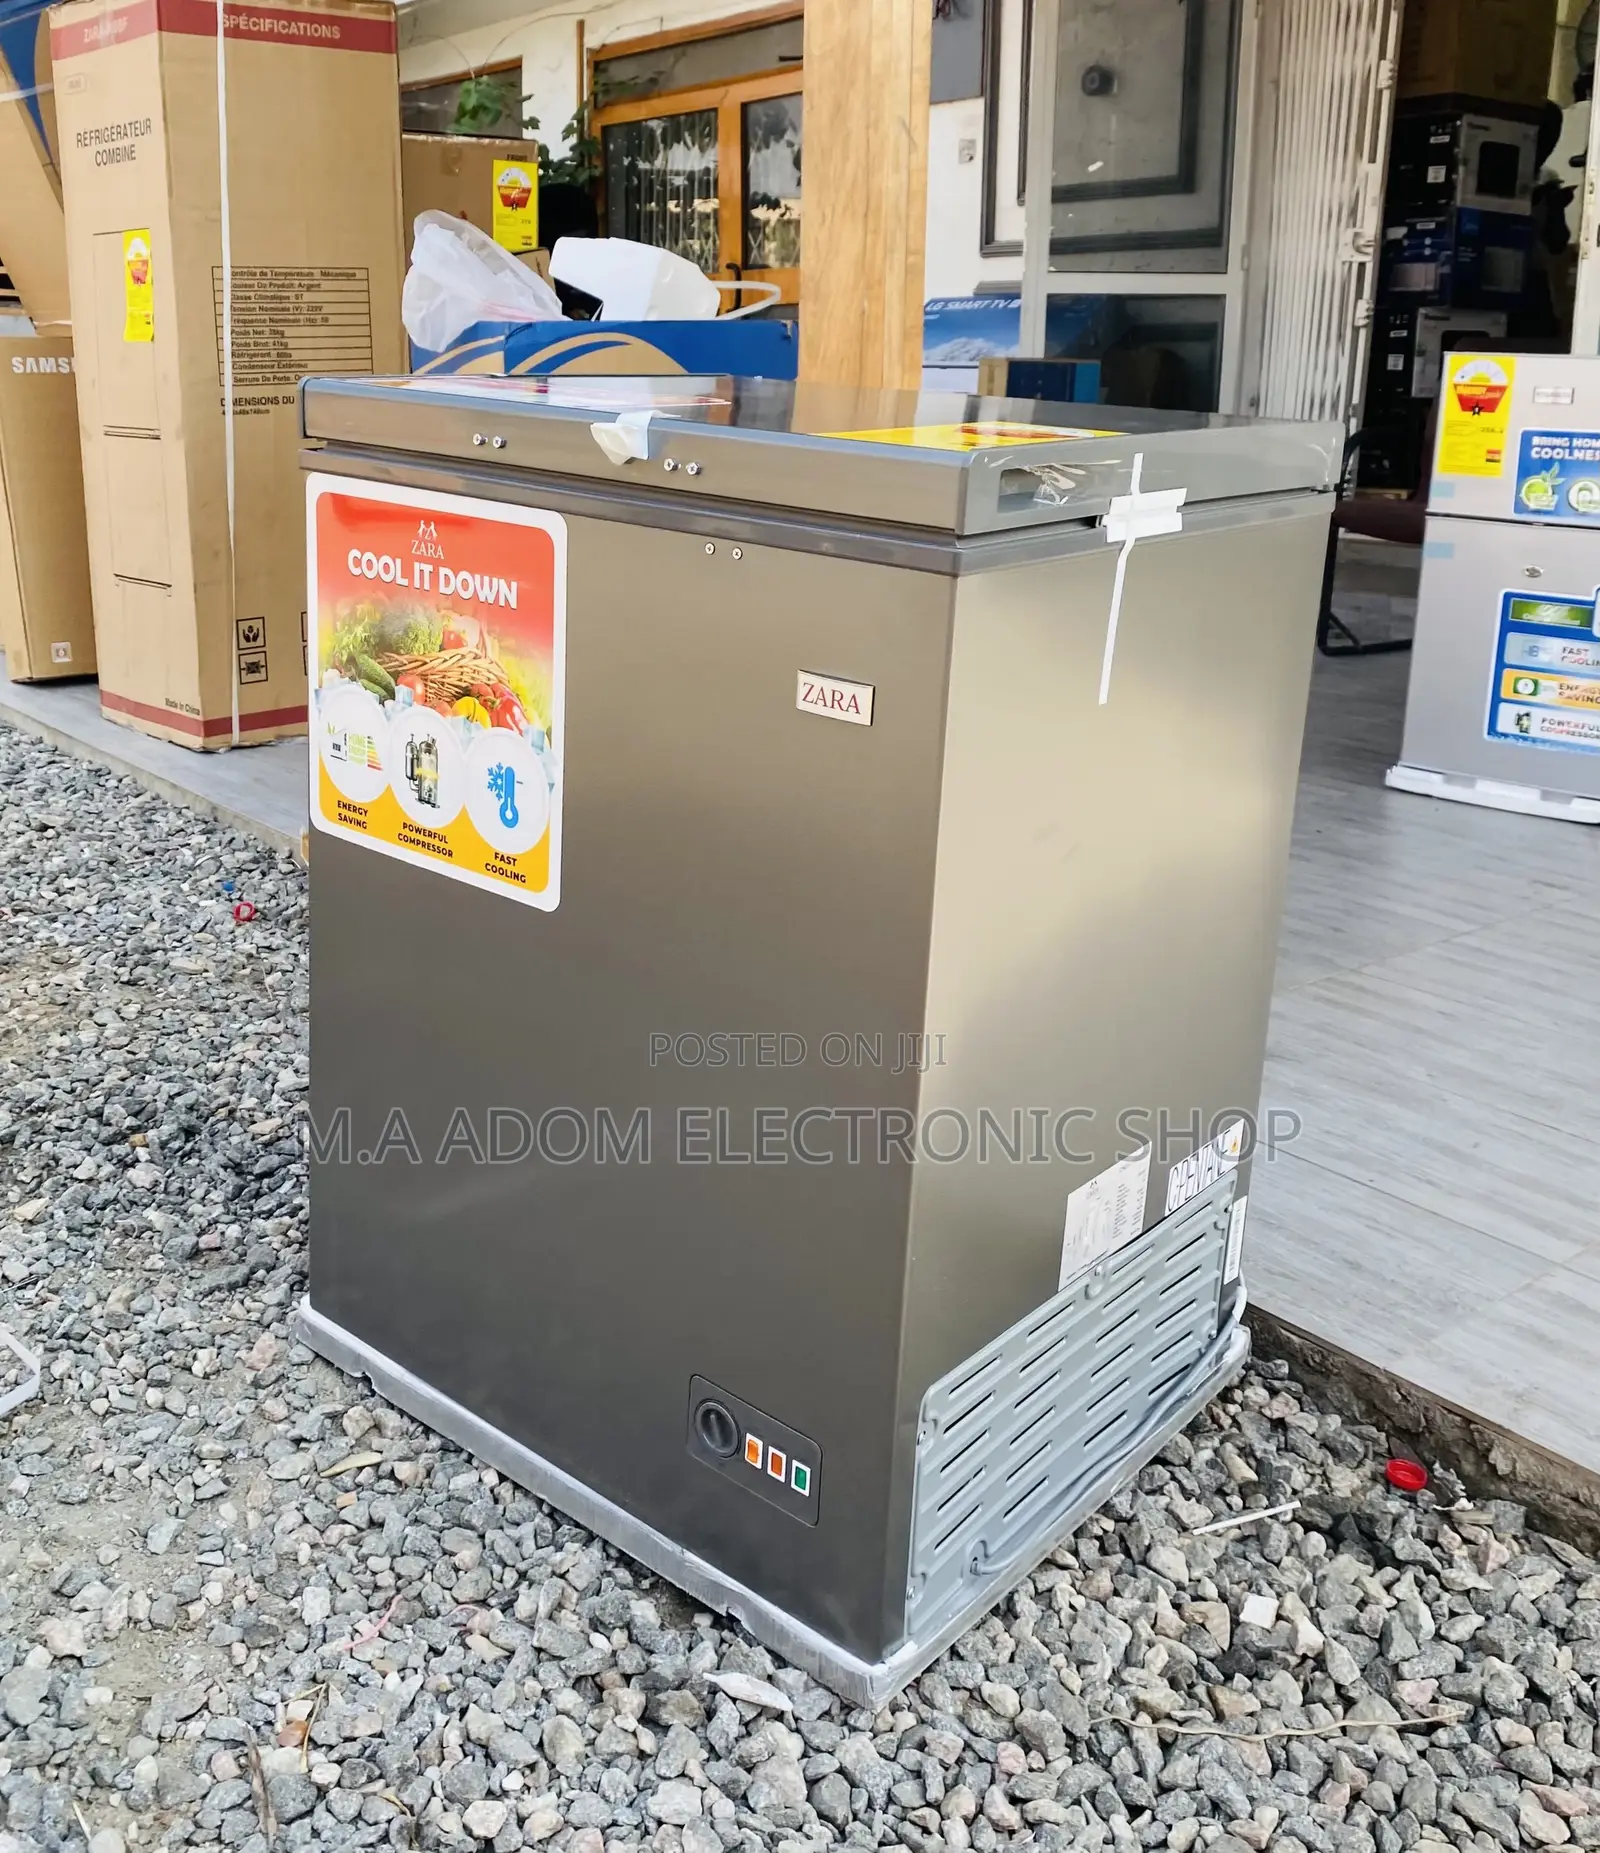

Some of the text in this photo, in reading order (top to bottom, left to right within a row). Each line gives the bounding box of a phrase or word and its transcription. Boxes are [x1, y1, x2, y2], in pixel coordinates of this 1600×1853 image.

[94, 144, 137, 167] COMBINE
[925, 302, 945, 312] LG
[944, 300, 991, 310] SMART
[11, 356, 74, 374] SAMS
[220, 395, 280, 407] DMENSIONS
[1572, 437, 1600, 449] HOM
[411, 539, 445, 560] ZARA
[347, 549, 518, 610] COOL IT DOWN
[802, 682, 862, 716] ZARA
[337, 800, 369, 817] ENERGY
[337, 812, 368, 830] SAVING
[402, 822, 449, 844] POWERFUL
[397, 832, 454, 859] COMPRESSOR
[494, 852, 518, 867] FAST
[484, 863, 527, 884] COOLING
